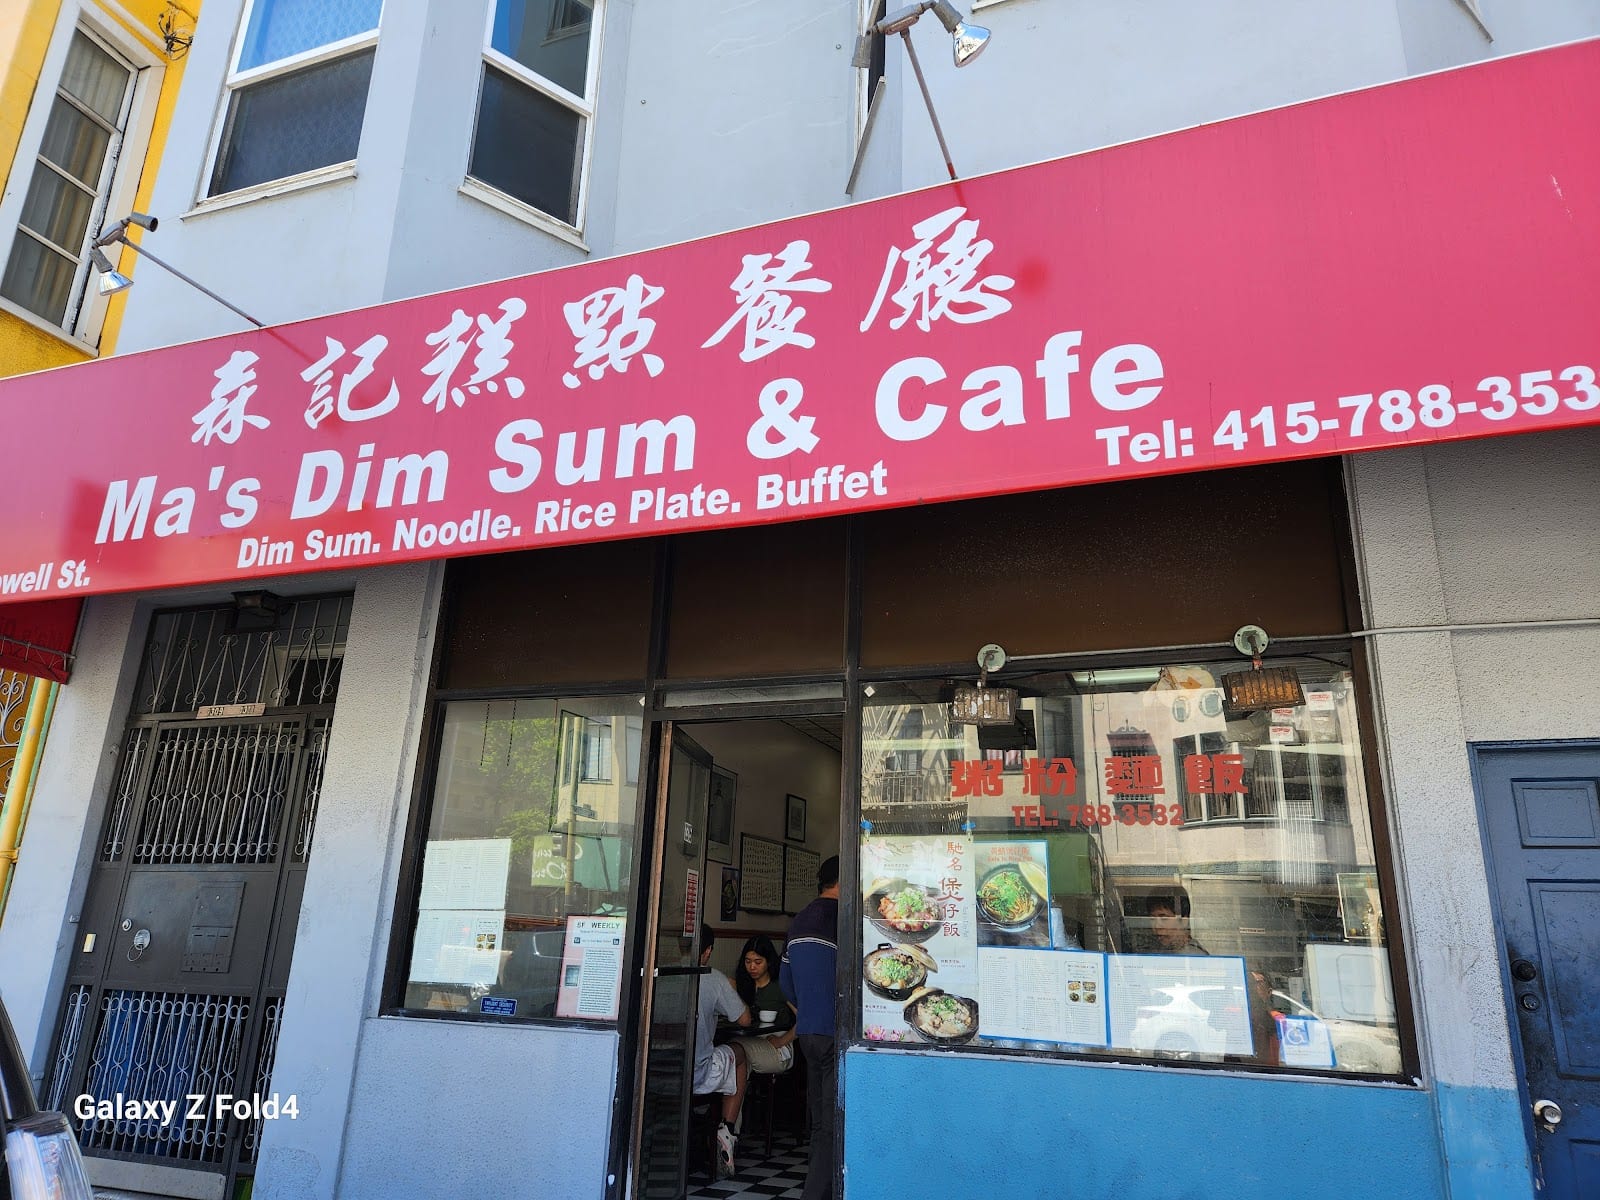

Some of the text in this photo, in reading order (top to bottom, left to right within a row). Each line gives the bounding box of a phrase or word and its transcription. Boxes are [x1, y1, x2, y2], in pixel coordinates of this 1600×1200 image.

[94, 330, 1164, 545] Ma's Dim Sum & Cafe
[1095, 419, 1194, 466] Tel:
[236, 460, 888, 569] Dim Sum. Noodle. Rice Plate. Buffet
[0, 559, 91, 595] well St.
[1011, 803, 1185, 828] TEL: 788-3532
[591, 921, 621, 930] WEEKLY
